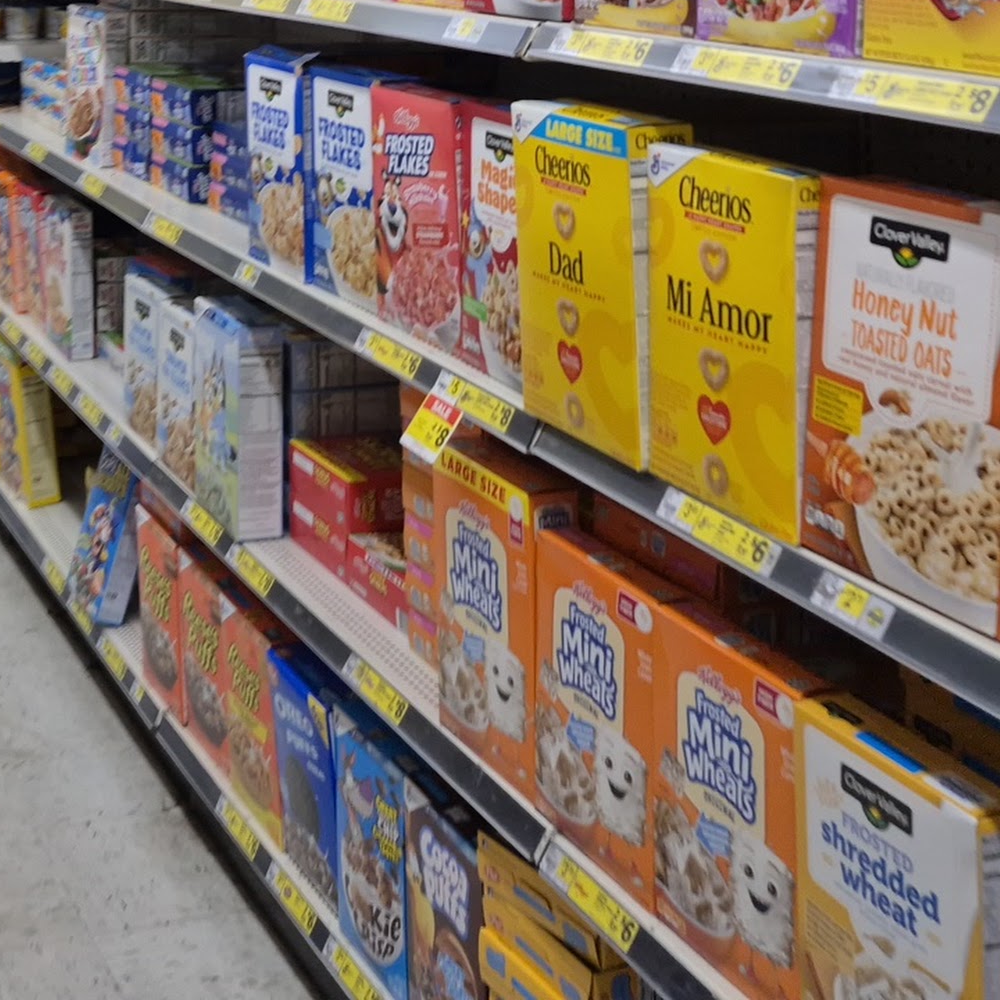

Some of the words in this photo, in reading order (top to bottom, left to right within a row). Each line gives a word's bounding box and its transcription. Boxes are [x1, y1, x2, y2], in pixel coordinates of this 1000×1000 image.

[252, 102, 290, 129] FROSTED
[253, 121, 286, 150] FLAKES
[319, 118, 366, 148] FROSTED
[546, 118, 584, 145] LARGE
[586, 127, 614, 151] SIZE
[321, 140, 362, 170] FLAKES
[384, 134, 434, 155] FROSTED
[387, 154, 430, 175] FLAKES
[535, 145, 592, 187] Cheerios
[477, 182, 517, 214] Shape
[480, 159, 515, 190] Magi
[679, 175, 752, 224] Cheerios
[874, 222, 911, 245] Clover
[909, 231, 946, 255] Valley
[549, 241, 585, 286] Dad
[667, 274, 693, 318] Mi
[700, 287, 774, 343] Amor
[852, 278, 915, 337] Honey
[918, 299, 958, 340] Nut
[851, 318, 909, 363] TOASTED
[914, 341, 953, 378] OATS
[431, 398, 452, 420] SALE
[441, 452, 478, 485] LARGE
[480, 474, 507, 504] SIZE
[457, 521, 491, 556] Frosted
[453, 538, 498, 591] Mini
[452, 569, 502, 633] Wheats
[569, 602, 607, 646] Frosted
[561, 618, 615, 686] Mini
[557, 649, 618, 721] Wheats
[695, 687, 742, 739] Frosted
[687, 705, 753, 786] Mini
[683, 739, 757, 825] Wheats
[419, 824, 469, 903] Cocoa
[842, 810, 915, 874] FROSTED
[821, 820, 941, 926] shredded
[840, 861, 919, 938] wheat
